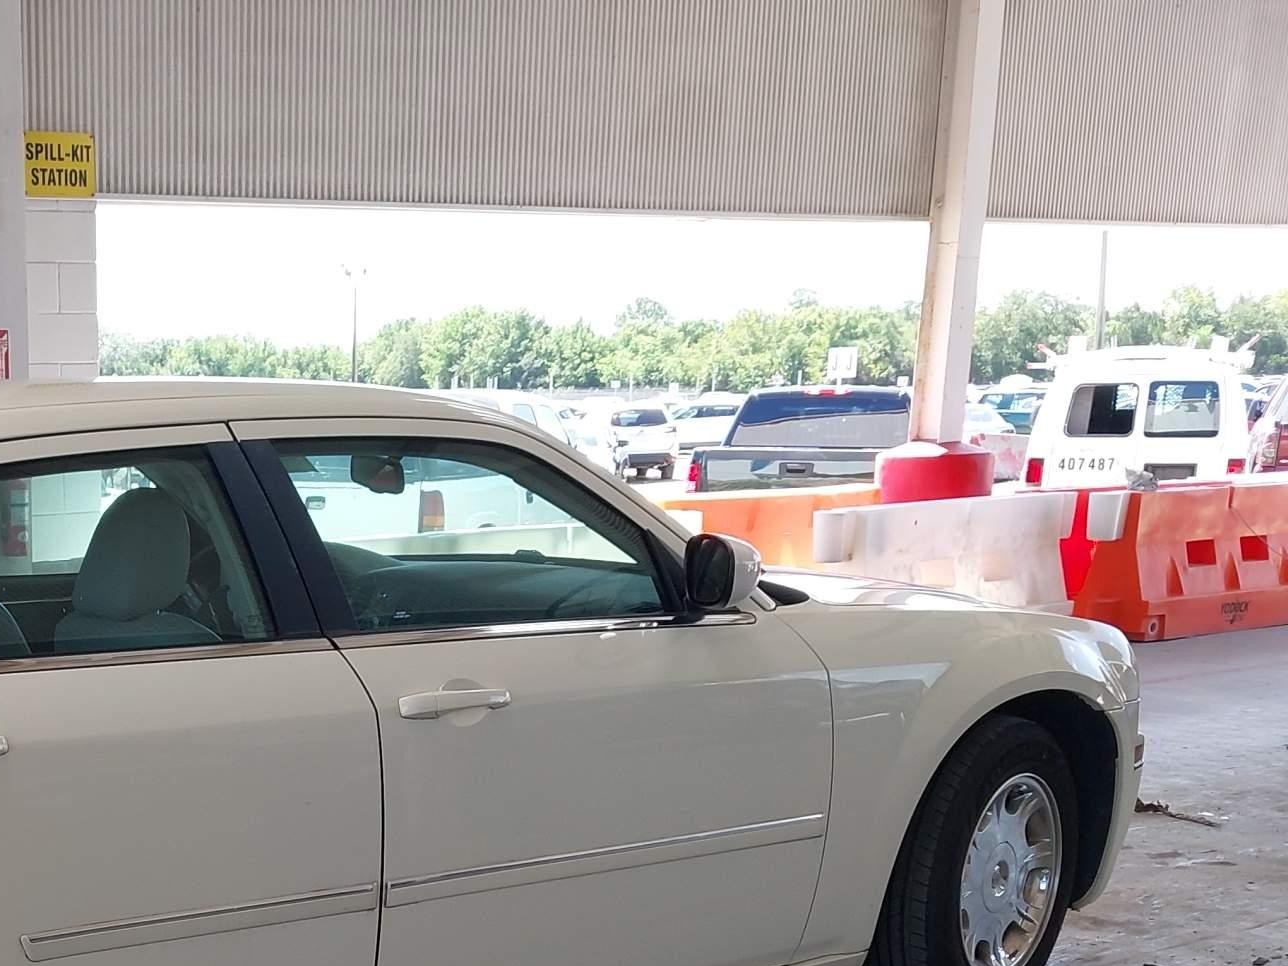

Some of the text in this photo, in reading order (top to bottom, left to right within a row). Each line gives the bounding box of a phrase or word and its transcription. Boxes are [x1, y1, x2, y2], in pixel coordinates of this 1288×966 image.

[25, 142, 92, 163] SPILL-KIT
[31, 167, 88, 188] STATION
[1058, 457, 1115, 471] 407487
